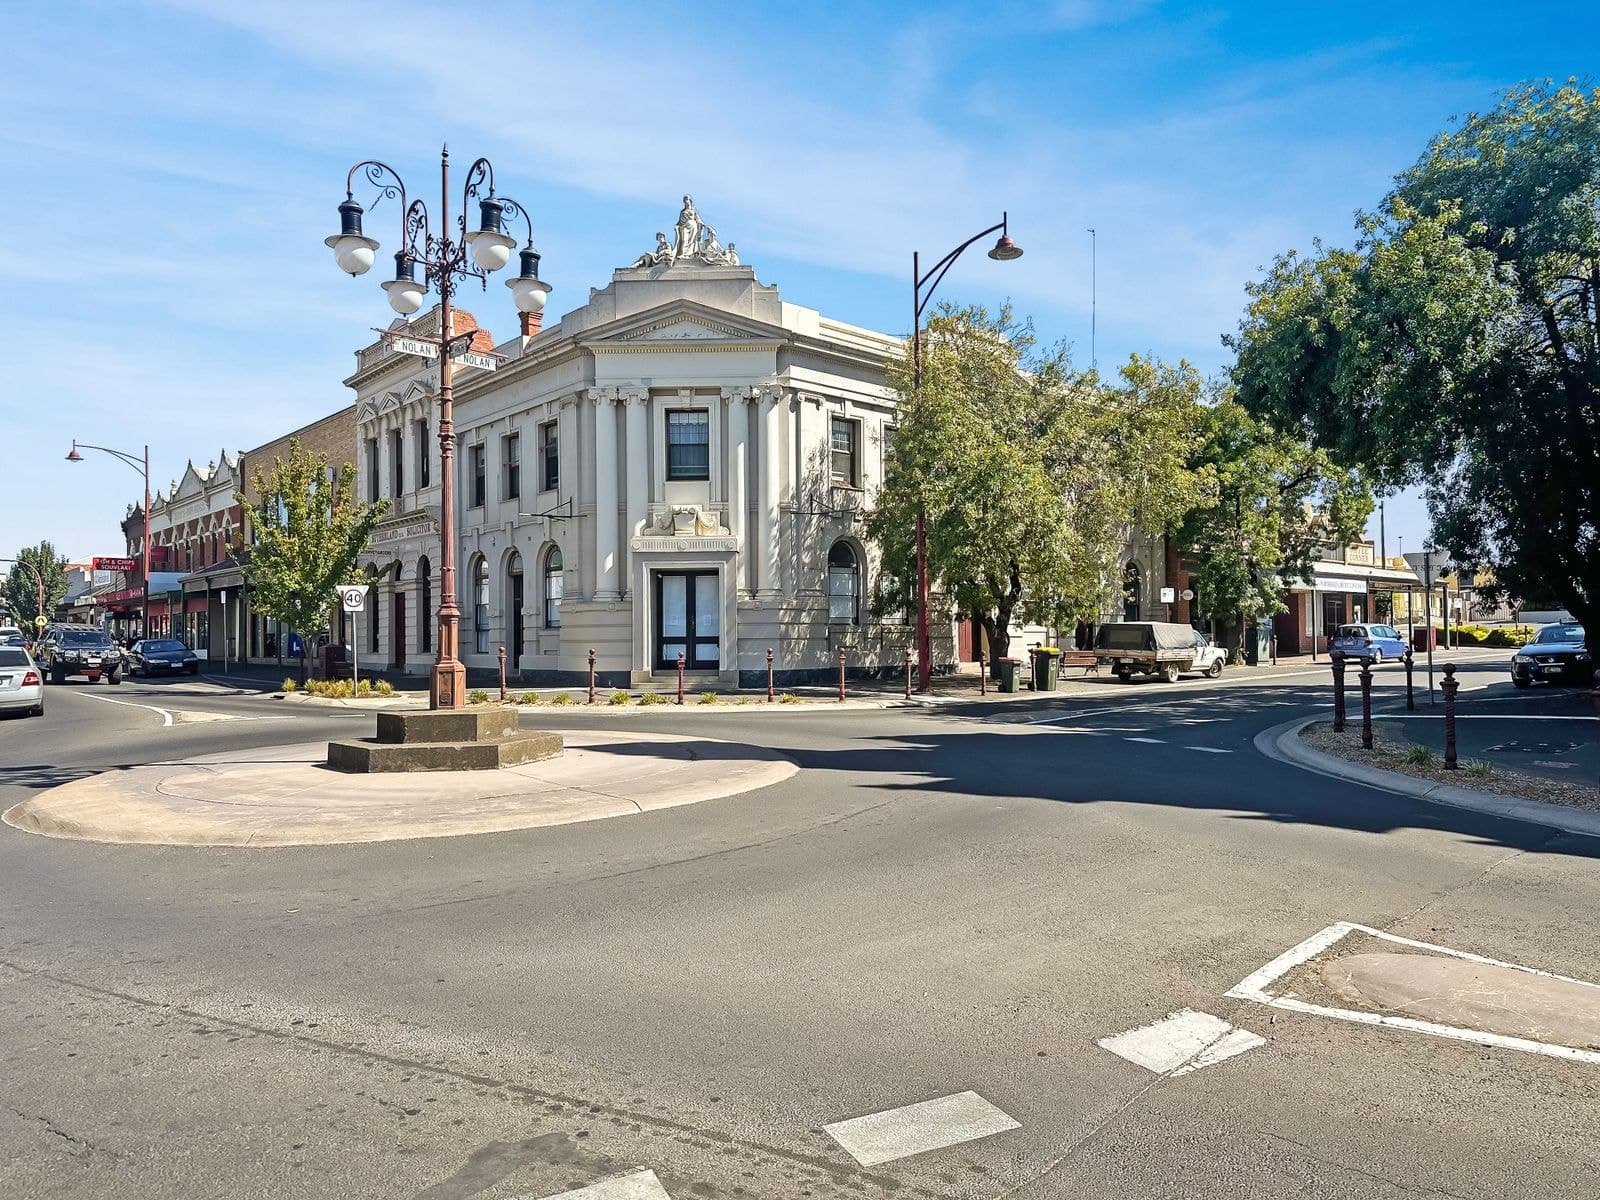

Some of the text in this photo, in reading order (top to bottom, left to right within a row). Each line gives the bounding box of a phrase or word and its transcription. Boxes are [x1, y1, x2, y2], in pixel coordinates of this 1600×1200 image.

[402, 341, 431, 355] NOLAN
[464, 353, 490, 368] NOLAN
[407, 523, 431, 537] SOLICITOR
[347, 594, 361, 603] 40
